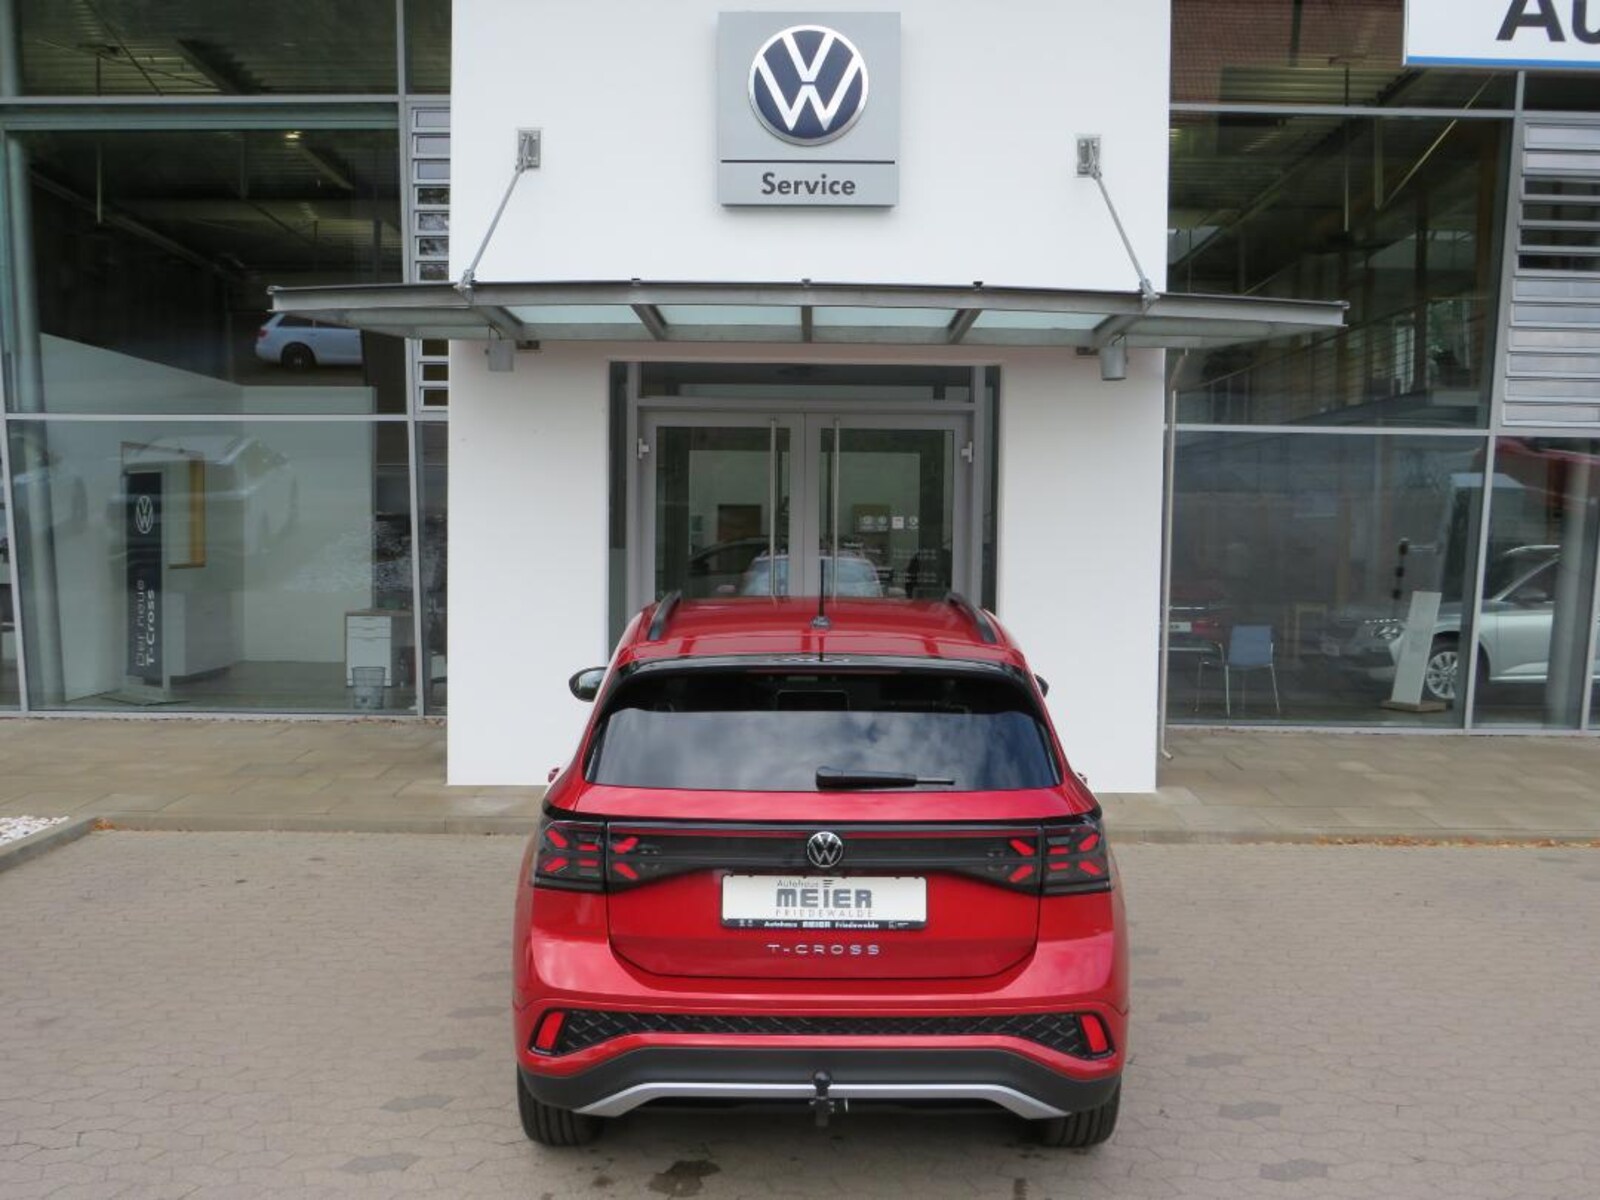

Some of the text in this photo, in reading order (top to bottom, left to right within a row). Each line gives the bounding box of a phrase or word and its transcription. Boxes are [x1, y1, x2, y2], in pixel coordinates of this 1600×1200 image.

[752, 28, 865, 135] VW
[761, 171, 856, 196] Service
[145, 588, 156, 667] T-Cross
[776, 879, 819, 888] Autohaus
[776, 888, 873, 909] MEIER
[775, 909, 873, 918] FRIEDEWALDE
[764, 920, 798, 929] Autohaus
[802, 921, 831, 929] MEIER
[835, 921, 880, 930] Friedewalde
[766, 943, 880, 955] T-CROSS
